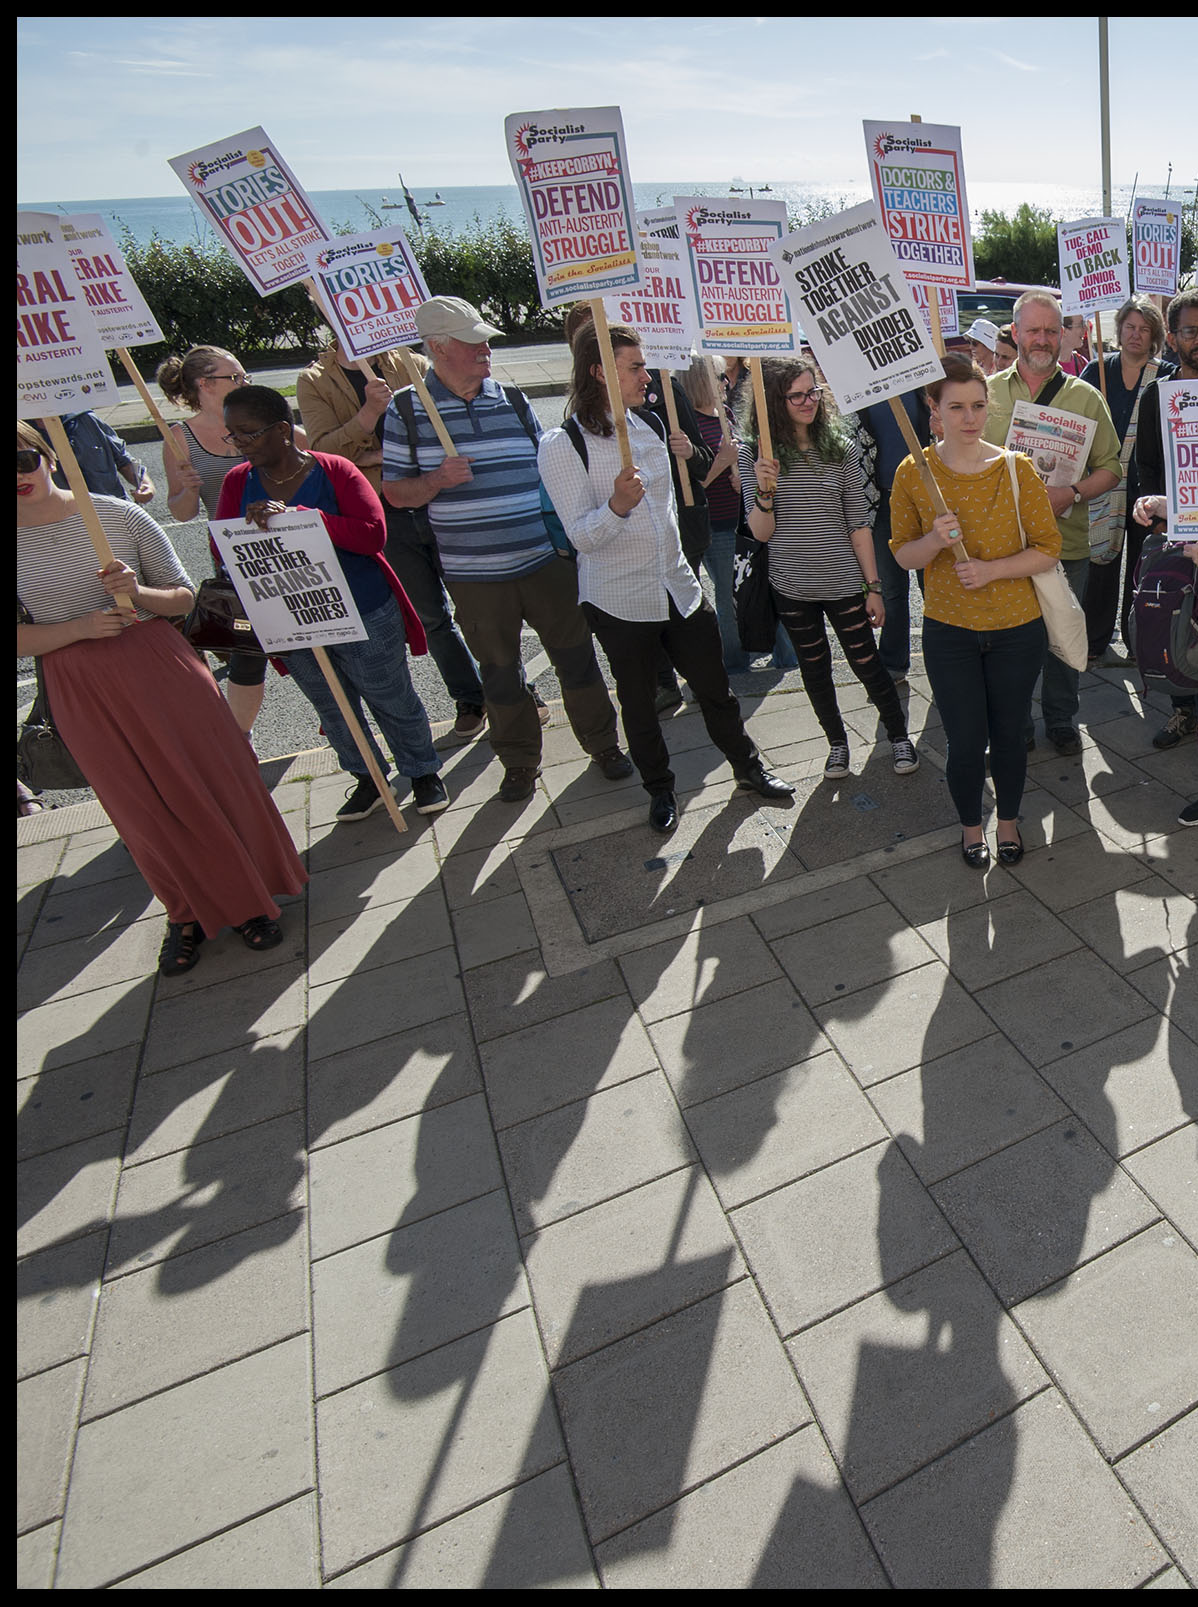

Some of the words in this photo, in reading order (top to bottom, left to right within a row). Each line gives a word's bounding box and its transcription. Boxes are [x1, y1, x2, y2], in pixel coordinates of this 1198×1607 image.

[529, 125, 585, 137] Socialist
[886, 135, 932, 147] Socialist
[198, 150, 243, 171] Socialist
[529, 152, 612, 182] #KEEPCORBYN
[209, 167, 289, 217] TORIES
[882, 168, 943, 190] DOCTORS
[945, 174, 955, 191] &
[531, 181, 621, 220] DEFEND
[885, 190, 955, 214] TEACHERS
[229, 192, 313, 251] OUT!
[539, 211, 624, 239] ANTI-AUSTERITY
[700, 208, 751, 219] Socialist
[889, 212, 960, 244] STRIKE
[1064, 236, 1085, 251] TUC:
[1086, 228, 1110, 244] CALL
[1137, 223, 1176, 244] TORIES
[250, 249, 276, 266] LET'S
[275, 242, 291, 257] ALL
[290, 230, 322, 248] STRIKE
[327, 242, 373, 256] Socialist
[542, 230, 629, 263] STRUGGLE
[892, 240, 961, 265] TOGETHER
[1076, 242, 1103, 260] DEMO
[1138, 241, 1175, 269] OUT!
[326, 256, 408, 293] TORIES
[587, 258, 631, 274] Socialists
[697, 260, 780, 286] DEFEND
[795, 247, 851, 294] STRIKE
[1064, 262, 1083, 281] TO
[1085, 248, 1122, 274] BACK
[801, 261, 877, 316] TOGETHER
[1079, 281, 1121, 302] DOCTORS
[1081, 270, 1115, 288] JUNIOR
[338, 276, 418, 322] OUT!
[701, 286, 782, 301] ANTI-AUSTERITY
[620, 302, 682, 324] STRIKE
[703, 302, 785, 322] STRUGGLE
[816, 273, 900, 346] AGAINST
[349, 323, 374, 336] LET'S
[376, 315, 393, 325] ALL
[368, 322, 416, 341] TOGETHER
[852, 307, 914, 352] DIVIDED
[26, 347, 82, 362] AUSTERITY
[862, 328, 924, 371] TORIES!
[1038, 412, 1087, 434] Socialist
[1178, 514, 1197, 523] Join
[232, 536, 289, 562] STRIKE
[235, 550, 312, 579] TOGETHER
[248, 561, 333, 602] AGAINST
[282, 586, 343, 611] DIVIDED
[290, 602, 349, 626] TORIES!
